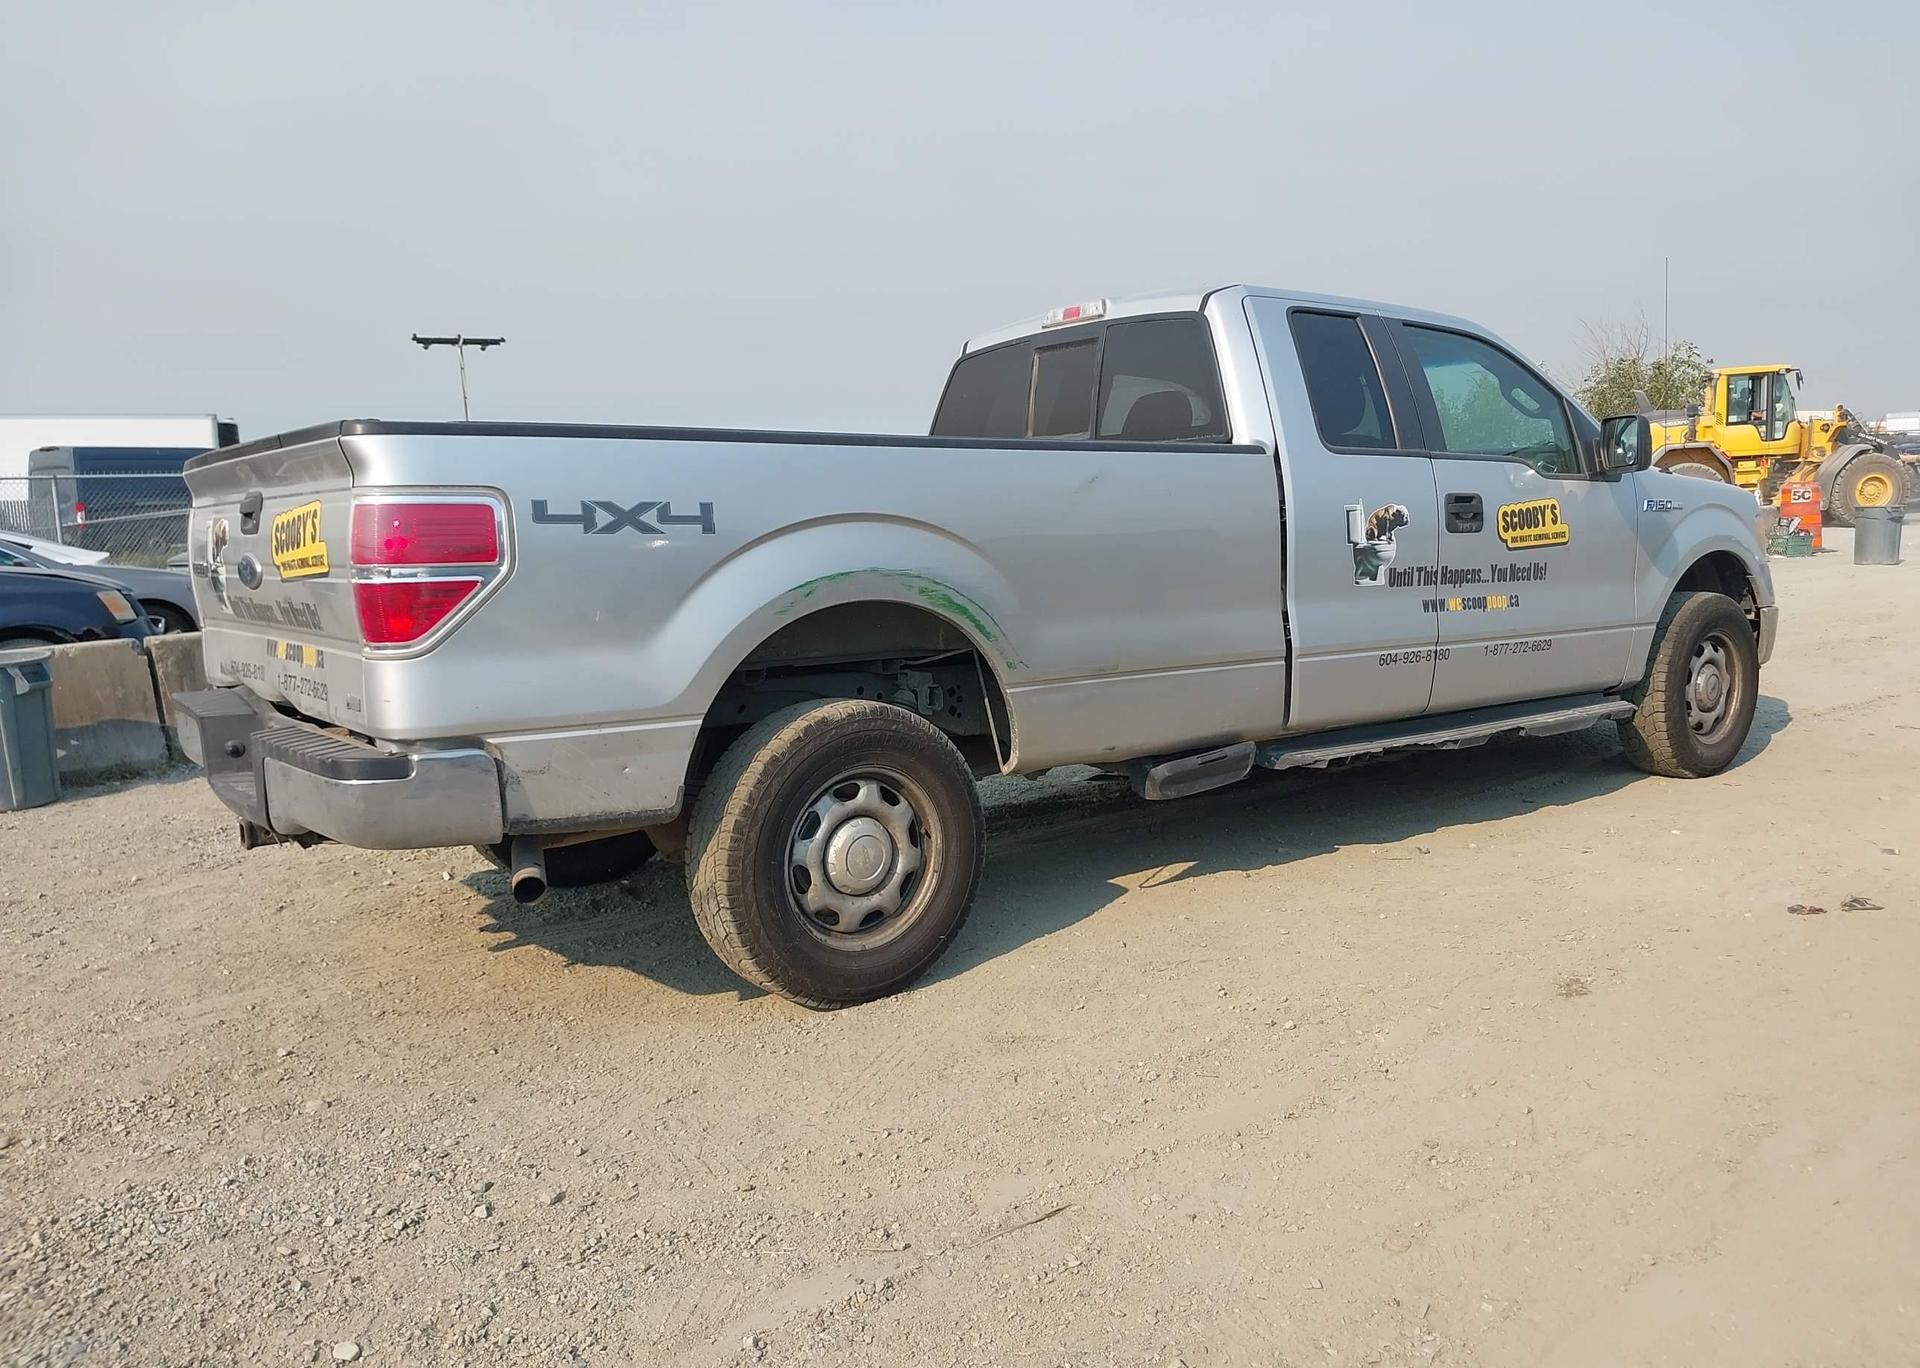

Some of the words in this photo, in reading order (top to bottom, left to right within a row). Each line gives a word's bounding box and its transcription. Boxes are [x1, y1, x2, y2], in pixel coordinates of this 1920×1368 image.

[1792, 490, 1811, 500] 5C
[1502, 504, 1558, 533] SCOOBY'S
[274, 509, 318, 556] SCOOBY'S
[1550, 530, 1567, 540] SERVICE
[1388, 566, 1415, 588] Until
[1415, 565, 1439, 587] This
[1440, 565, 1490, 589] Happens...
[1490, 563, 1508, 584] You
[1508, 562, 1533, 583] Need
[1532, 561, 1548, 582] Us!
[1422, 593, 1520, 614] www.wescooppoop.ca
[1378, 648, 1450, 667] 604-926-8180
[1484, 639, 1552, 657] 1-877-272-6629
[277, 673, 328, 702] 1-877-272-6629
